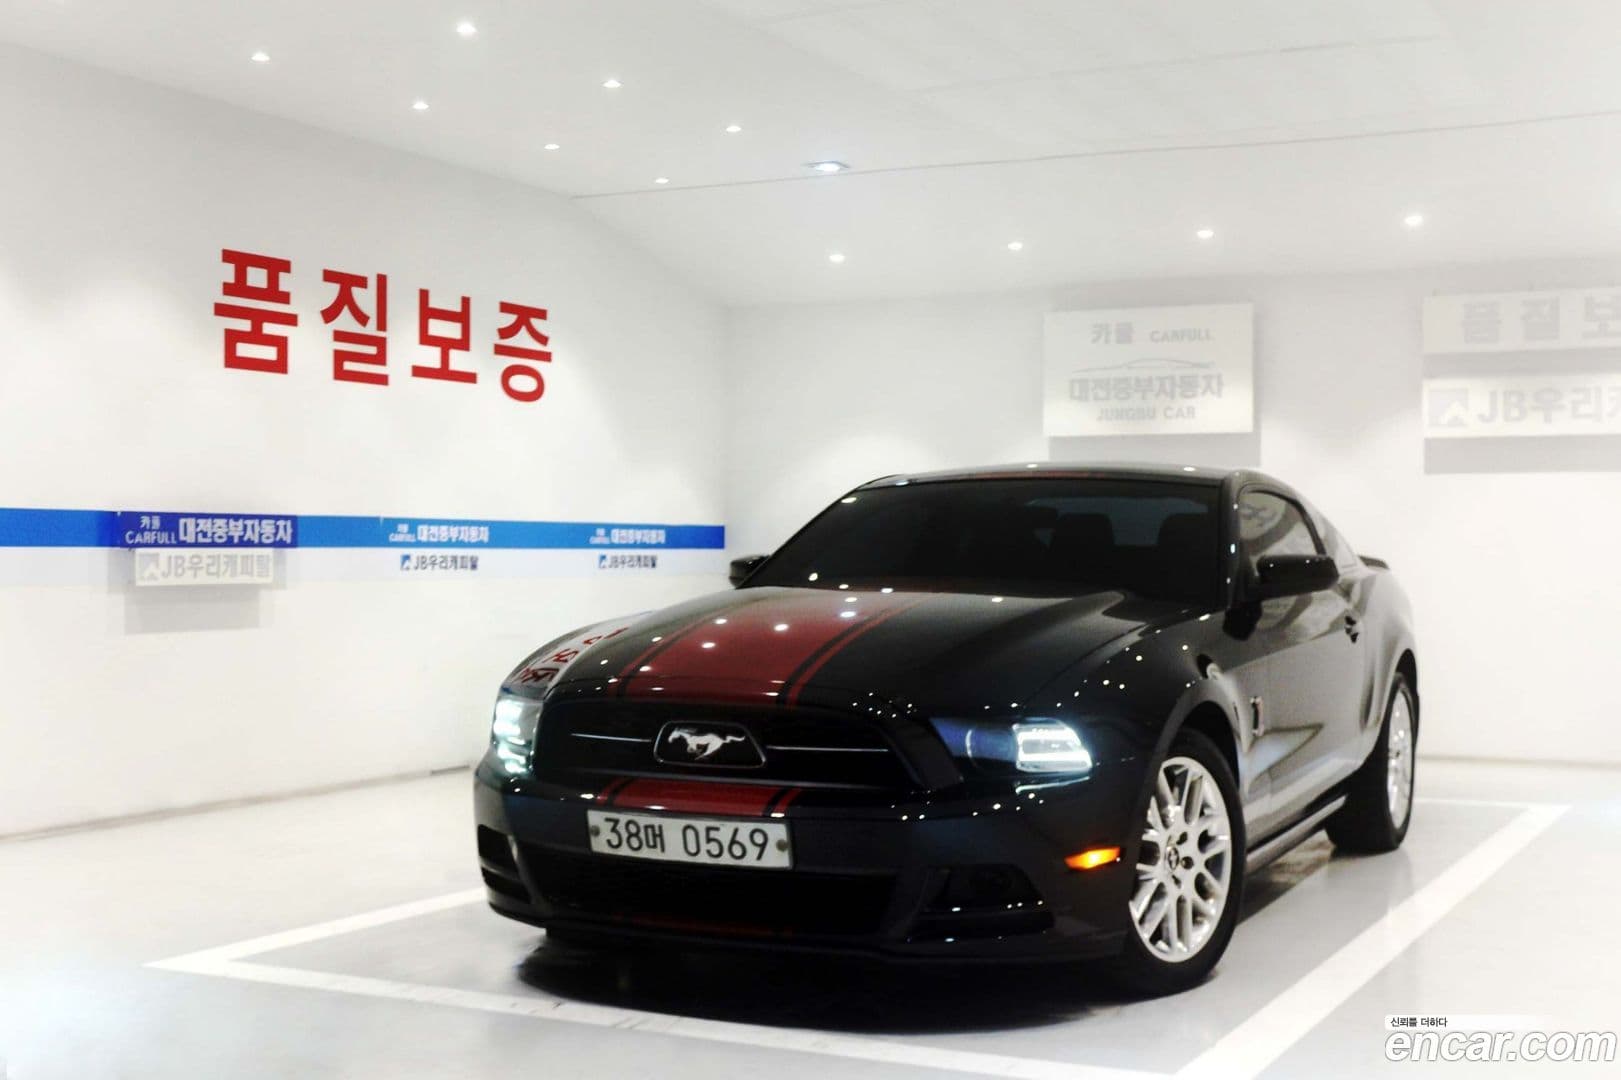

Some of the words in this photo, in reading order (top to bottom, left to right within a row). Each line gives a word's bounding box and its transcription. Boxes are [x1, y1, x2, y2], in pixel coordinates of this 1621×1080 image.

[214, 248, 552, 403] 품질보증
[1069, 373, 1224, 401] 대전중부자동차
[1096, 406, 1156, 421] JUNGBU
[1163, 406, 1196, 420] CAR
[124, 530, 177, 544] CARFULL
[179, 516, 293, 544] 대전중부자동차
[417, 524, 490, 543] 대전중부자동차
[161, 553, 270, 579] JB우리캐피탈
[603, 817, 665, 853] 38머
[682, 823, 769, 861] 0569
